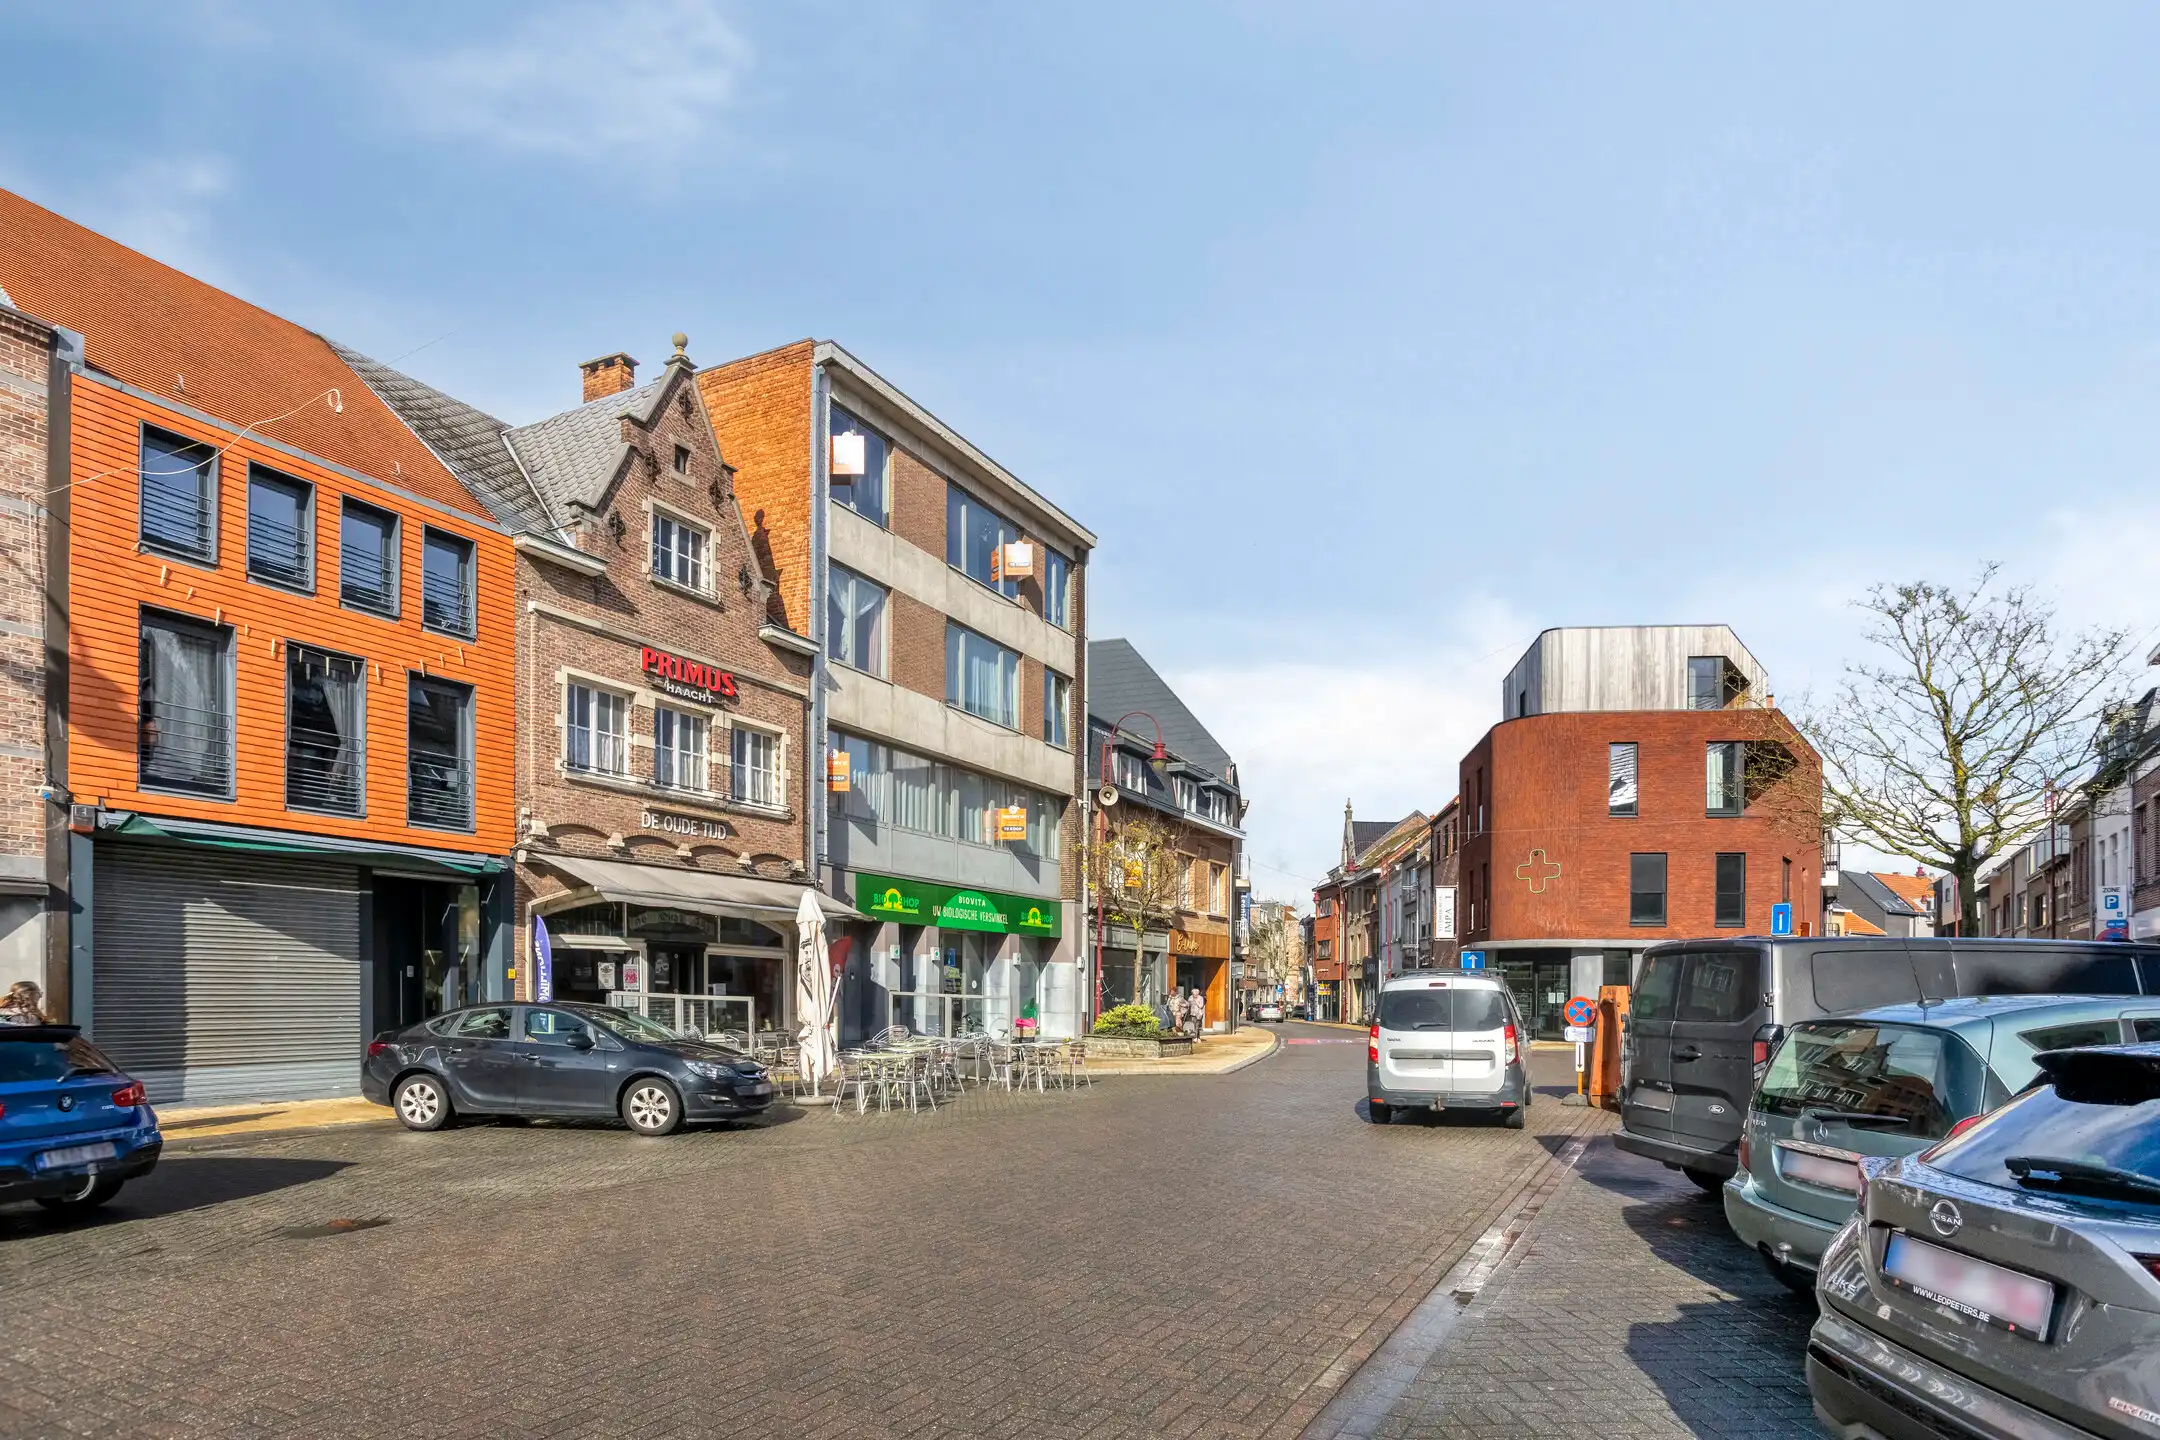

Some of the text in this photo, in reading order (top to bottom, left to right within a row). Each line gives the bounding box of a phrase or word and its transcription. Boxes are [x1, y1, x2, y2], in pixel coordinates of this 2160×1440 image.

[641, 647, 735, 697] PRIMUS
[666, 684, 714, 703] HAACHT
[641, 811, 726, 840] DE OUDE TIJD
[958, 895, 986, 907] BIOVITA
[2106, 896, 2117, 908] P
[932, 905, 1009, 925] UW BIOLOGISCHE VERSWINKEL
[1929, 1210, 1963, 1227] NISSAN
[1912, 1285, 1991, 1323] WWW.LEOPEETERS.BE
